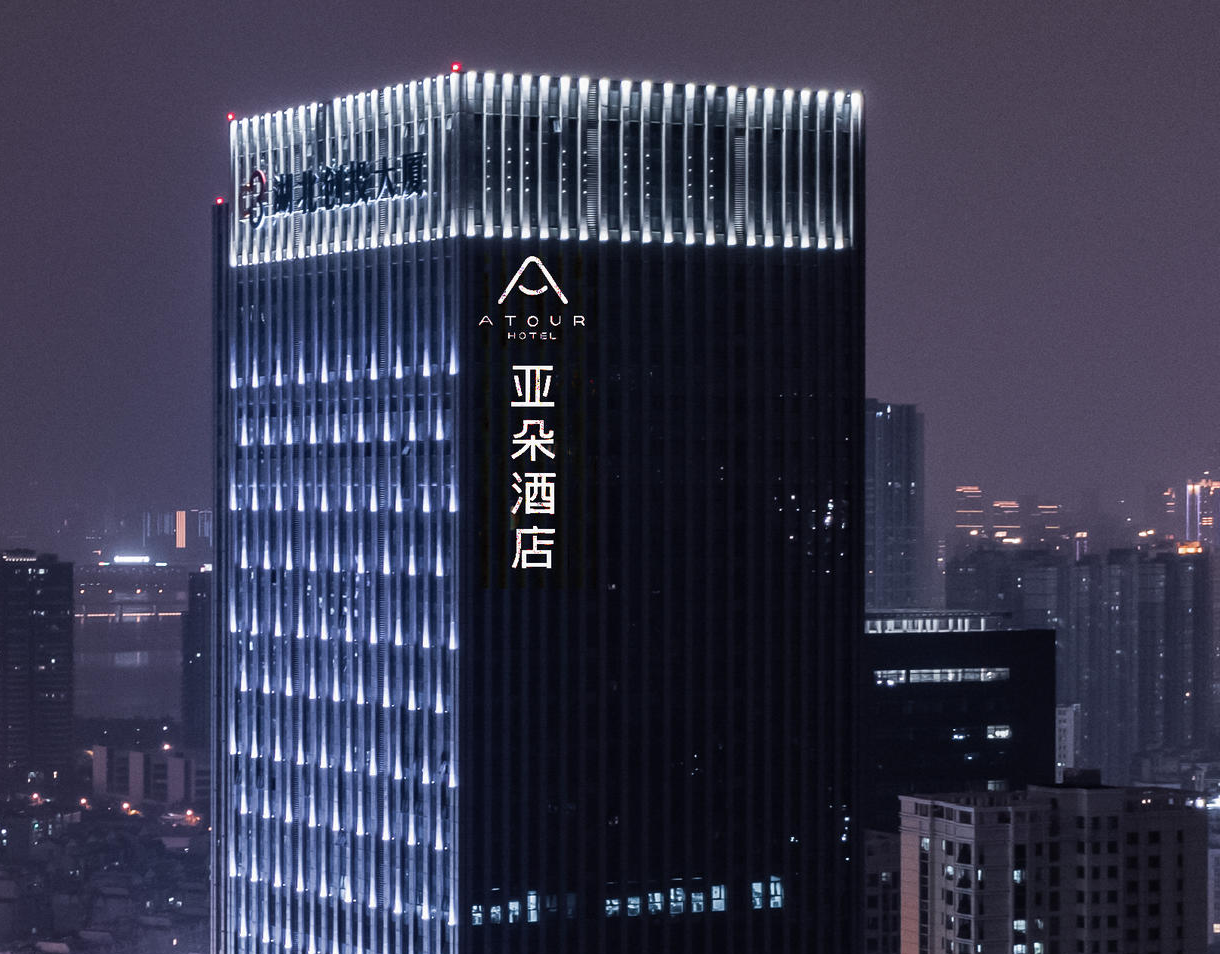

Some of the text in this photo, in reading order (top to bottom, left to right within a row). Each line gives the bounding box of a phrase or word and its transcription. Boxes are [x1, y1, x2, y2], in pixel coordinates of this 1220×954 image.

[478, 315, 586, 328] ATOUR
[507, 331, 557, 340] HOTEL
[511, 366, 556, 568] 亚朵酒店
